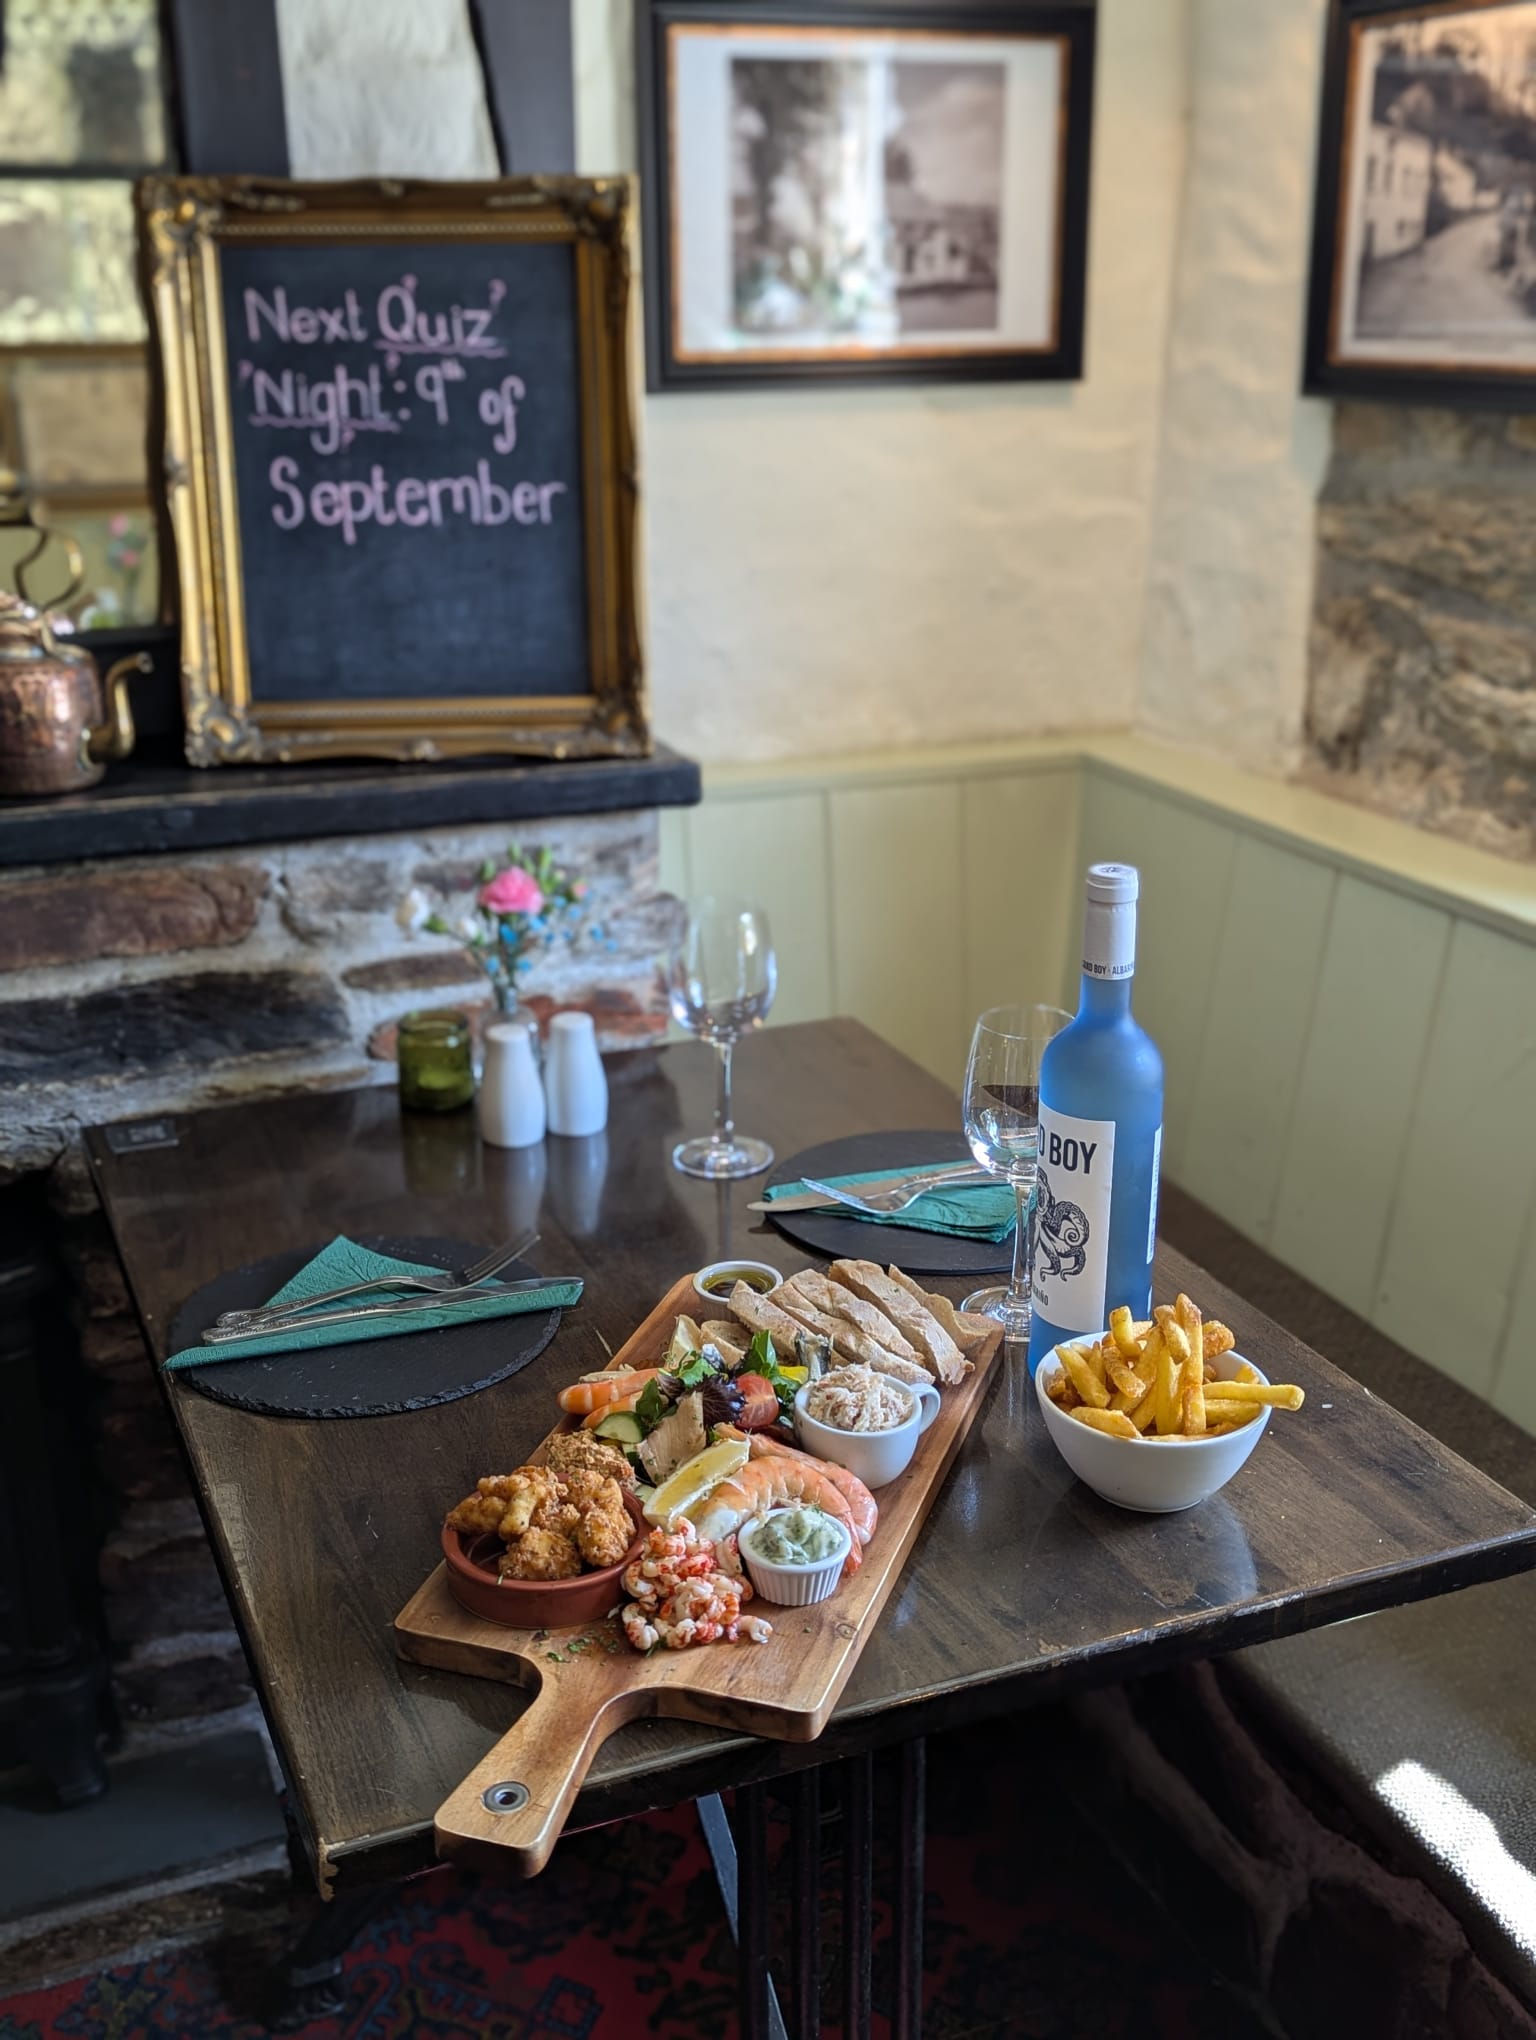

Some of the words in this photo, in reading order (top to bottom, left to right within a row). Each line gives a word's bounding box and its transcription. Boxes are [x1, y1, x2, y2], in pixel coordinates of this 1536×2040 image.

[244, 286, 368, 343] Next
[478, 376, 526, 454] of
[269, 456, 567, 545] September
[1049, 1131, 1098, 1174] BOY
